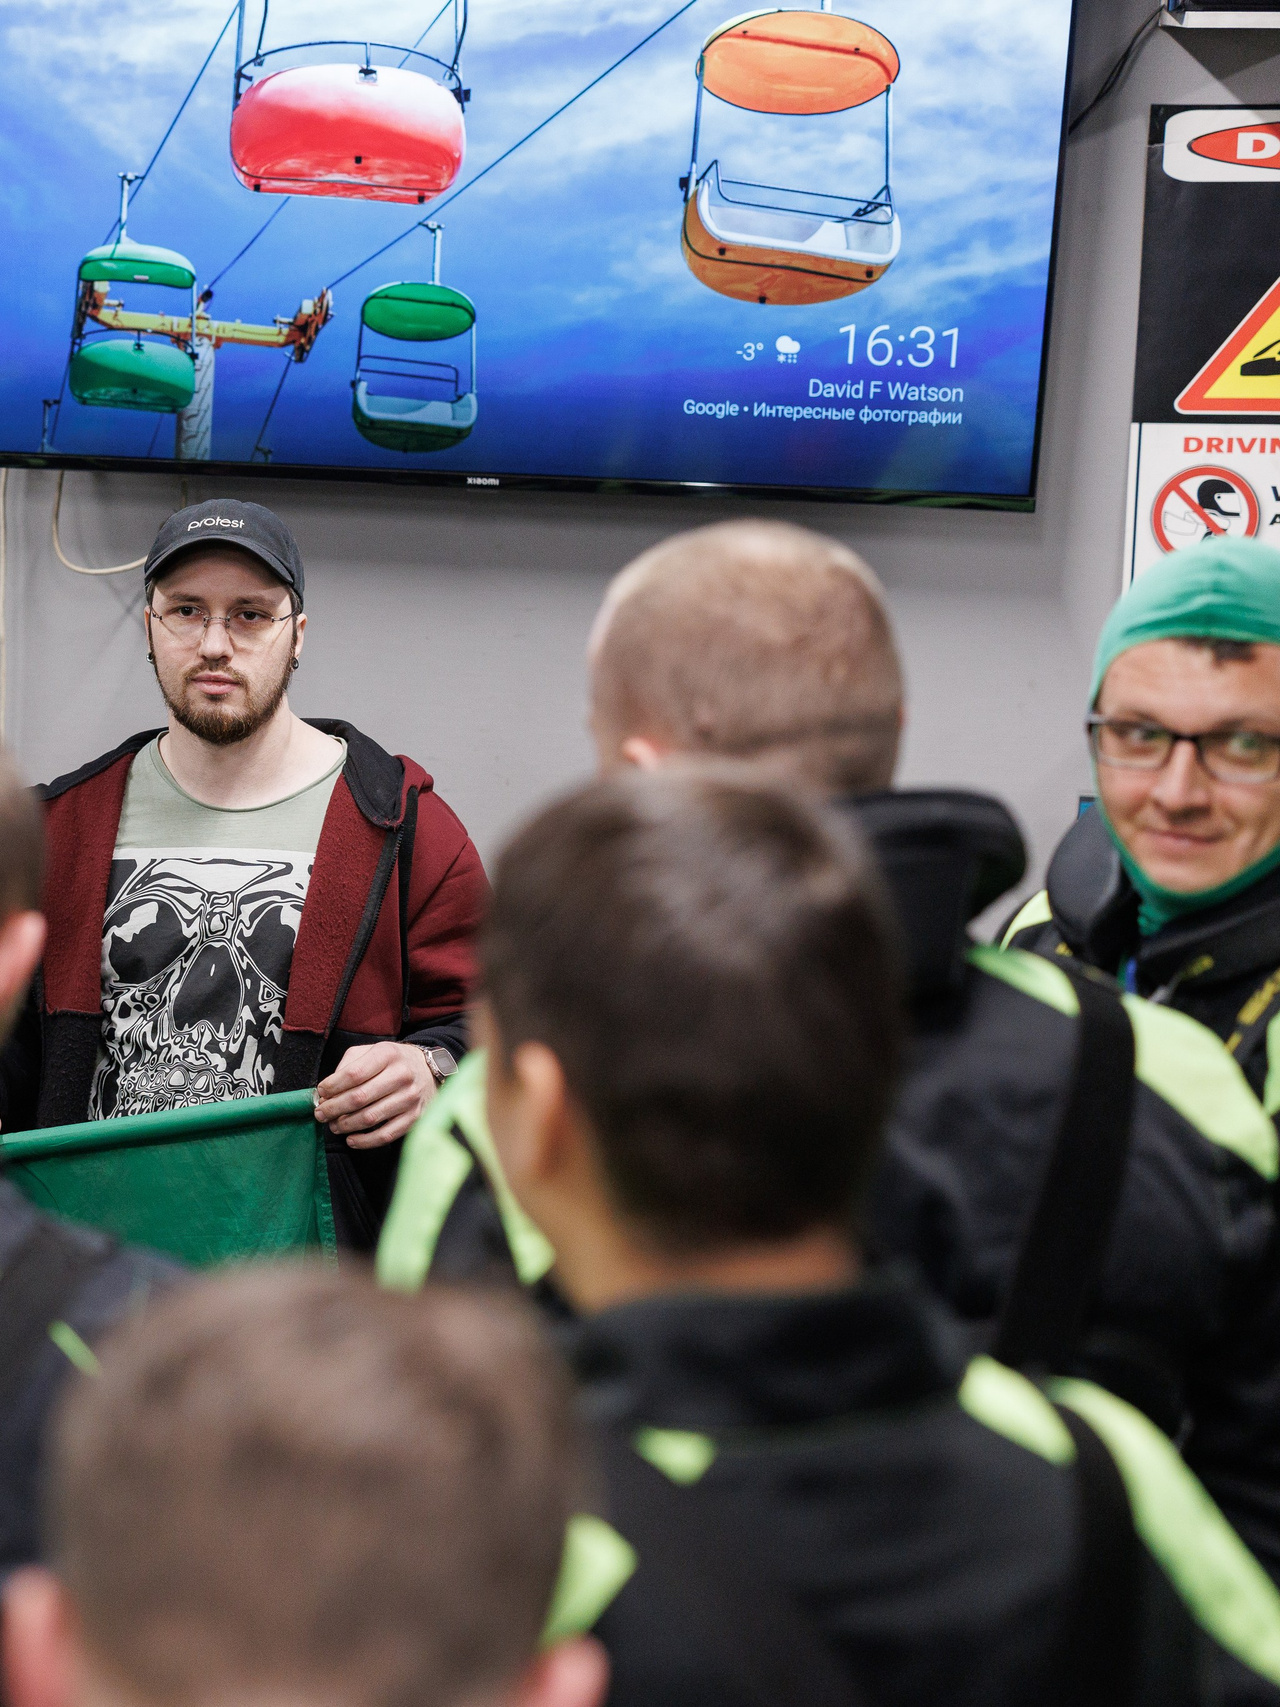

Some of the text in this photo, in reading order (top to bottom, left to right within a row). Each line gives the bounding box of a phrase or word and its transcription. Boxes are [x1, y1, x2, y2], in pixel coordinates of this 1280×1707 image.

[736, 324, 960, 369] -3° 16:31
[808, 378, 964, 403] David F Watson
[683, 399, 963, 427] Google Интересные фотографии
[187, 516, 245, 532] protest
